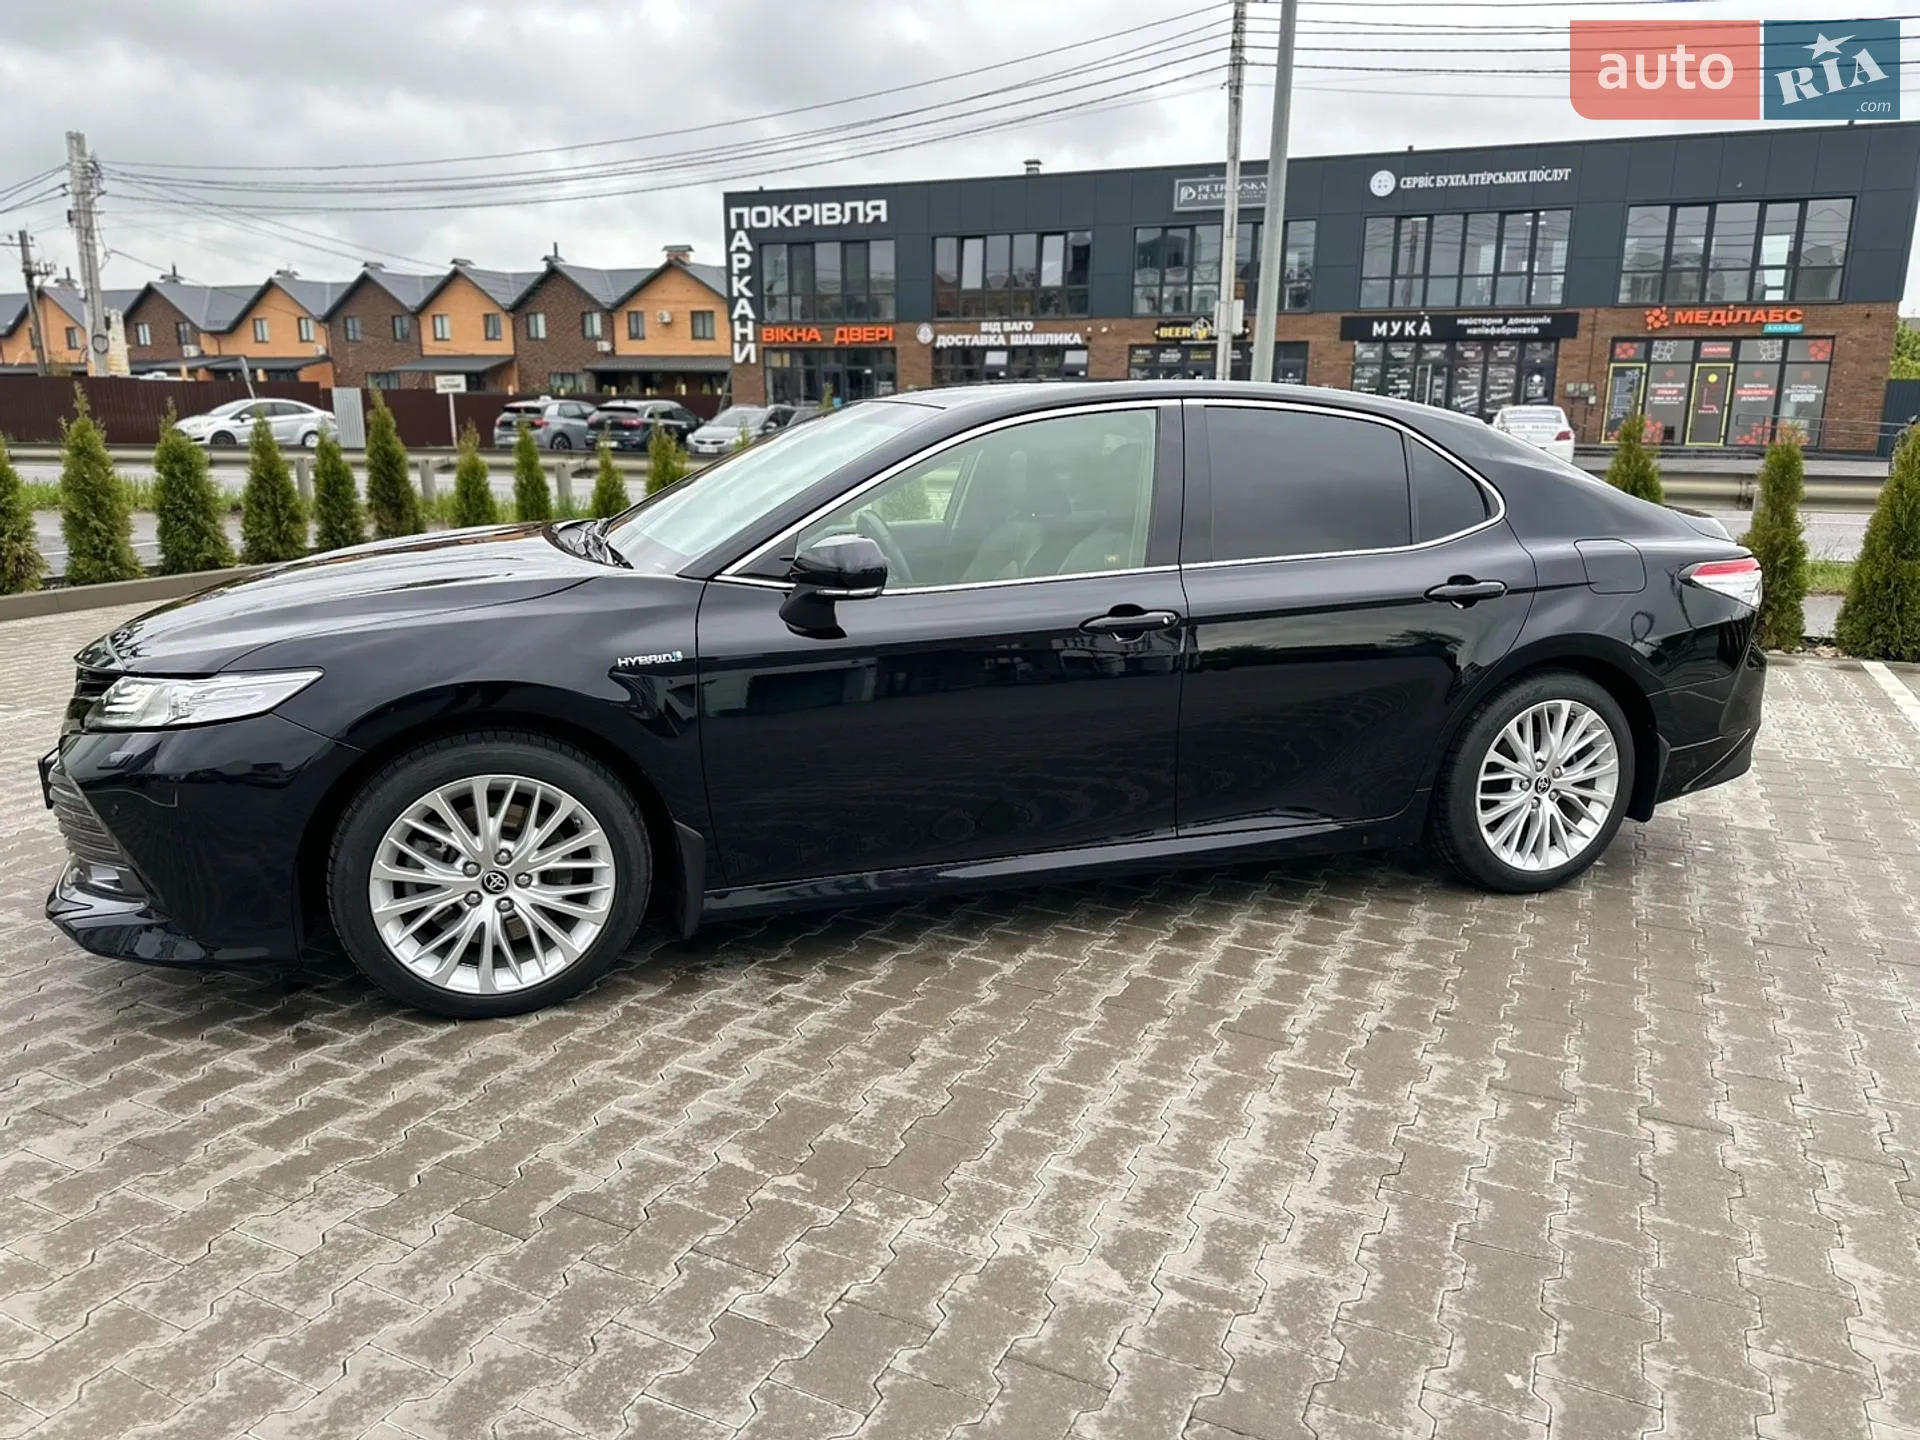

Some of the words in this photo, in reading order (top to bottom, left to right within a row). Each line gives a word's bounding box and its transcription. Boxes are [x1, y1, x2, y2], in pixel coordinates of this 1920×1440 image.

[729, 199, 888, 230] ПОКРІВЛЯ
[761, 326, 822, 343] ВІКНА
[834, 326, 895, 346] ДВЕРІ
[1371, 320, 1432, 337] МУКА
[936, 333, 1006, 348] ДОСТАВКА
[1010, 332, 1082, 346] ШАШЛИКА
[617, 653, 672, 667] HYBRID
